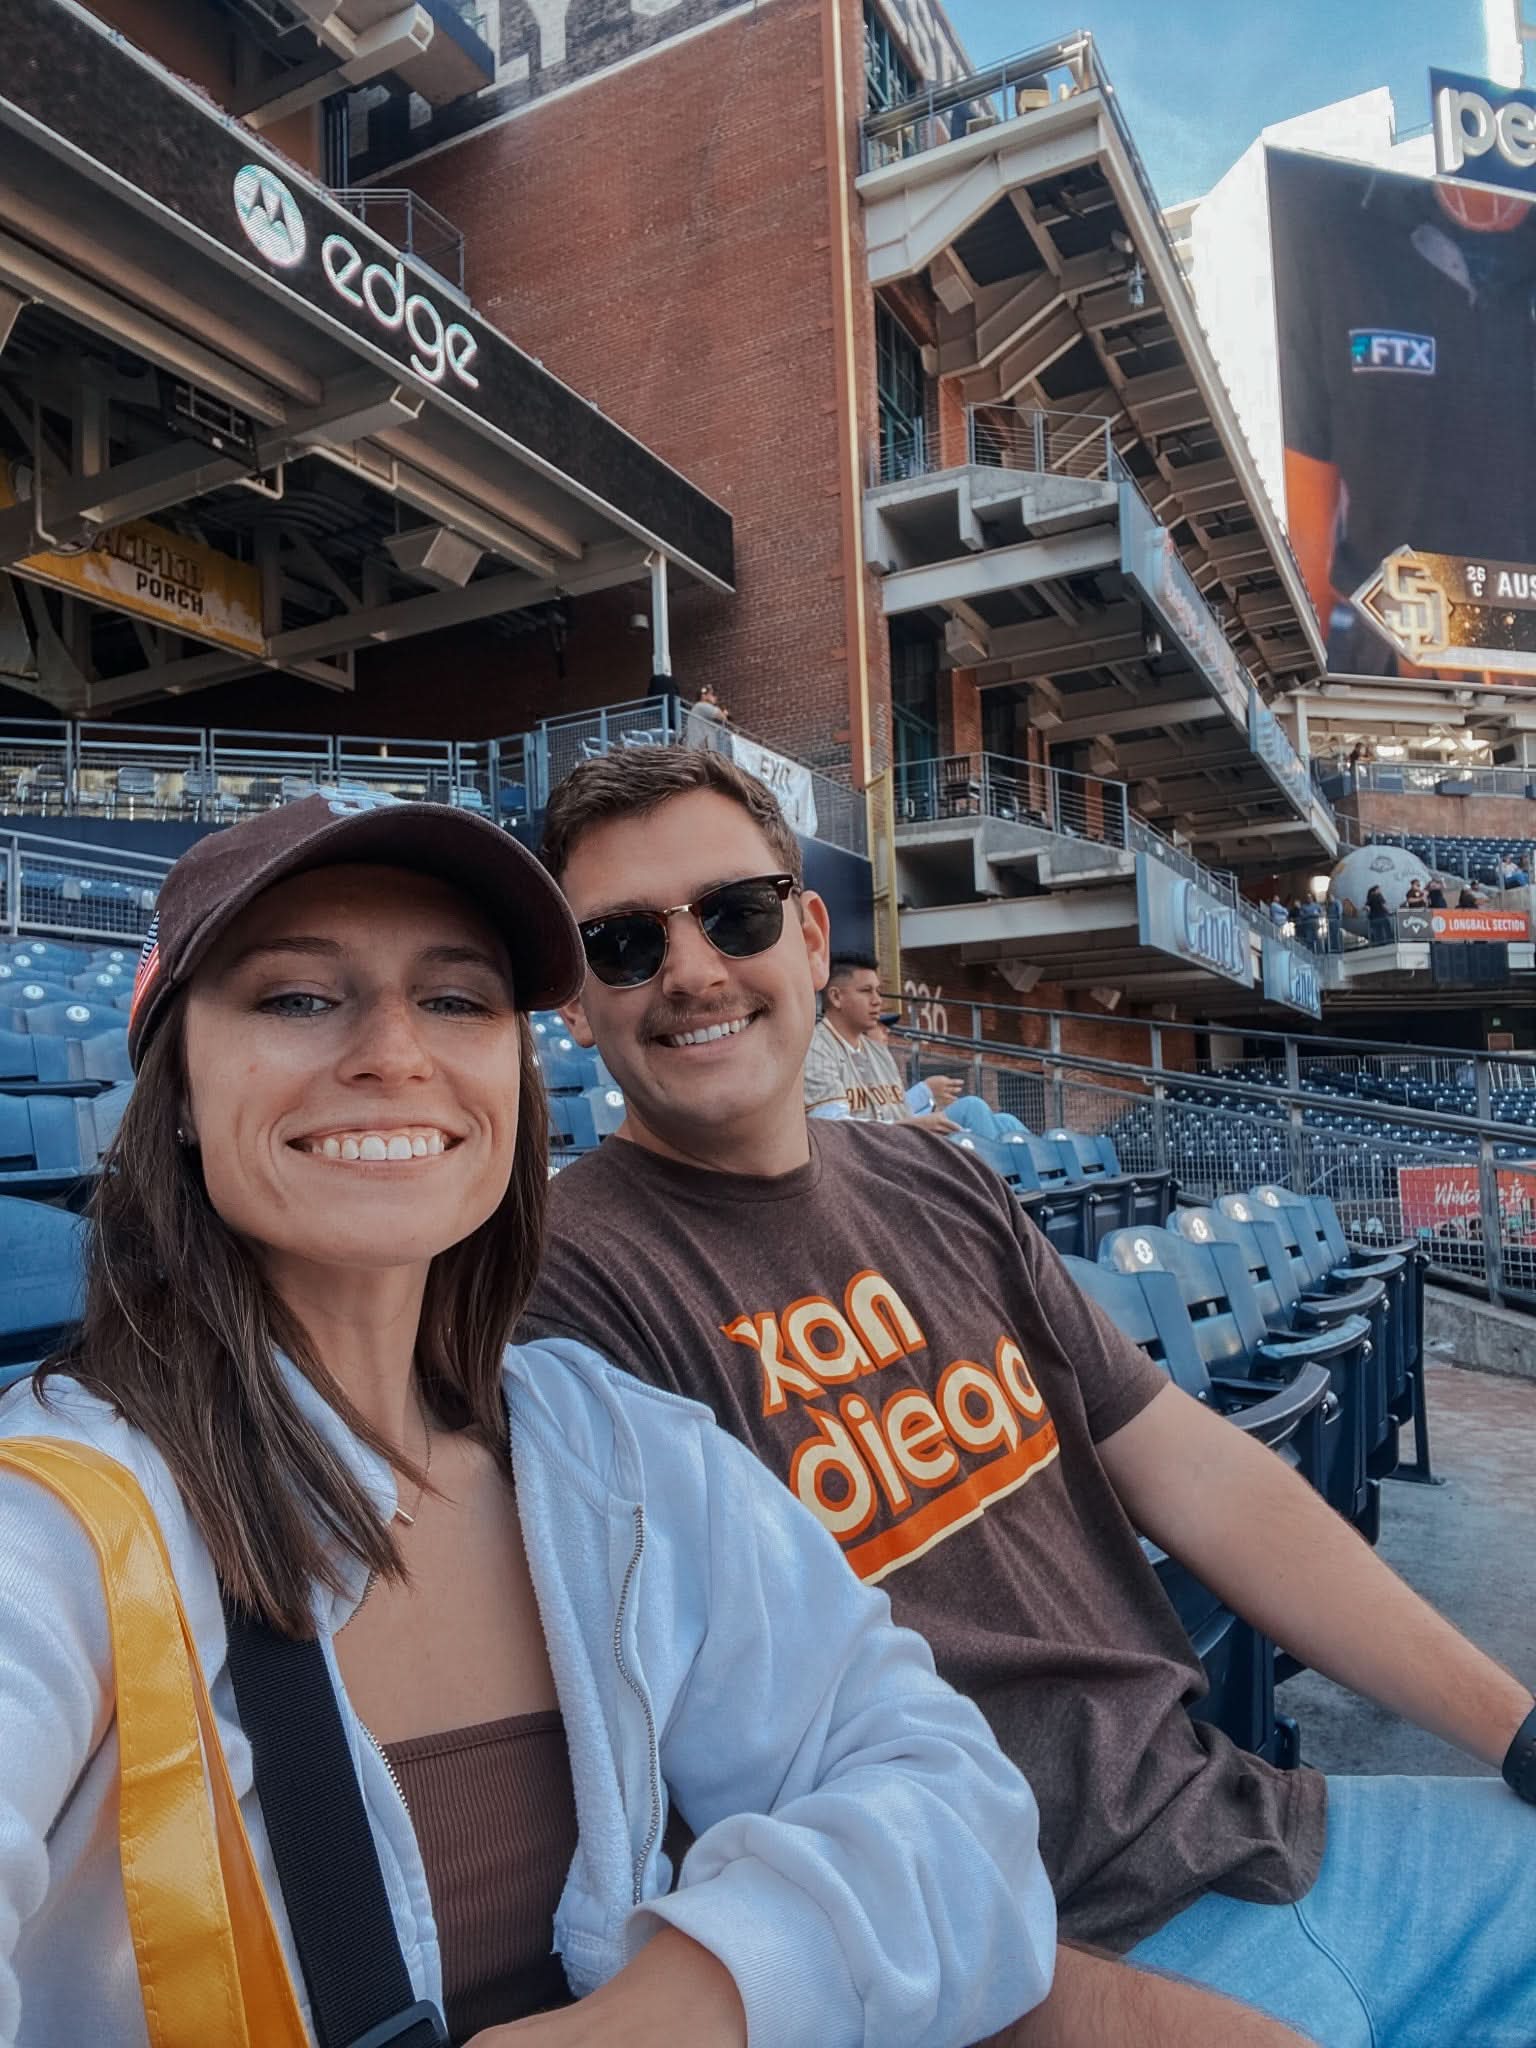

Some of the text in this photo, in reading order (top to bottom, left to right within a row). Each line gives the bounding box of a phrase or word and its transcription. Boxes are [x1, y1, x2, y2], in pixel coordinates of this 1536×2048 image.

[1437, 88, 1536, 172] pe
[322, 234, 479, 389] edge
[1370, 336, 1431, 368] FTX
[1466, 565, 1487, 582] 26
[1472, 582, 1484, 598] C
[136, 571, 204, 616] PORCH
[1450, 918, 1491, 932] LONGBALL
[1493, 918, 1526, 932] SECTION
[789, 1335, 1047, 1543] diego
